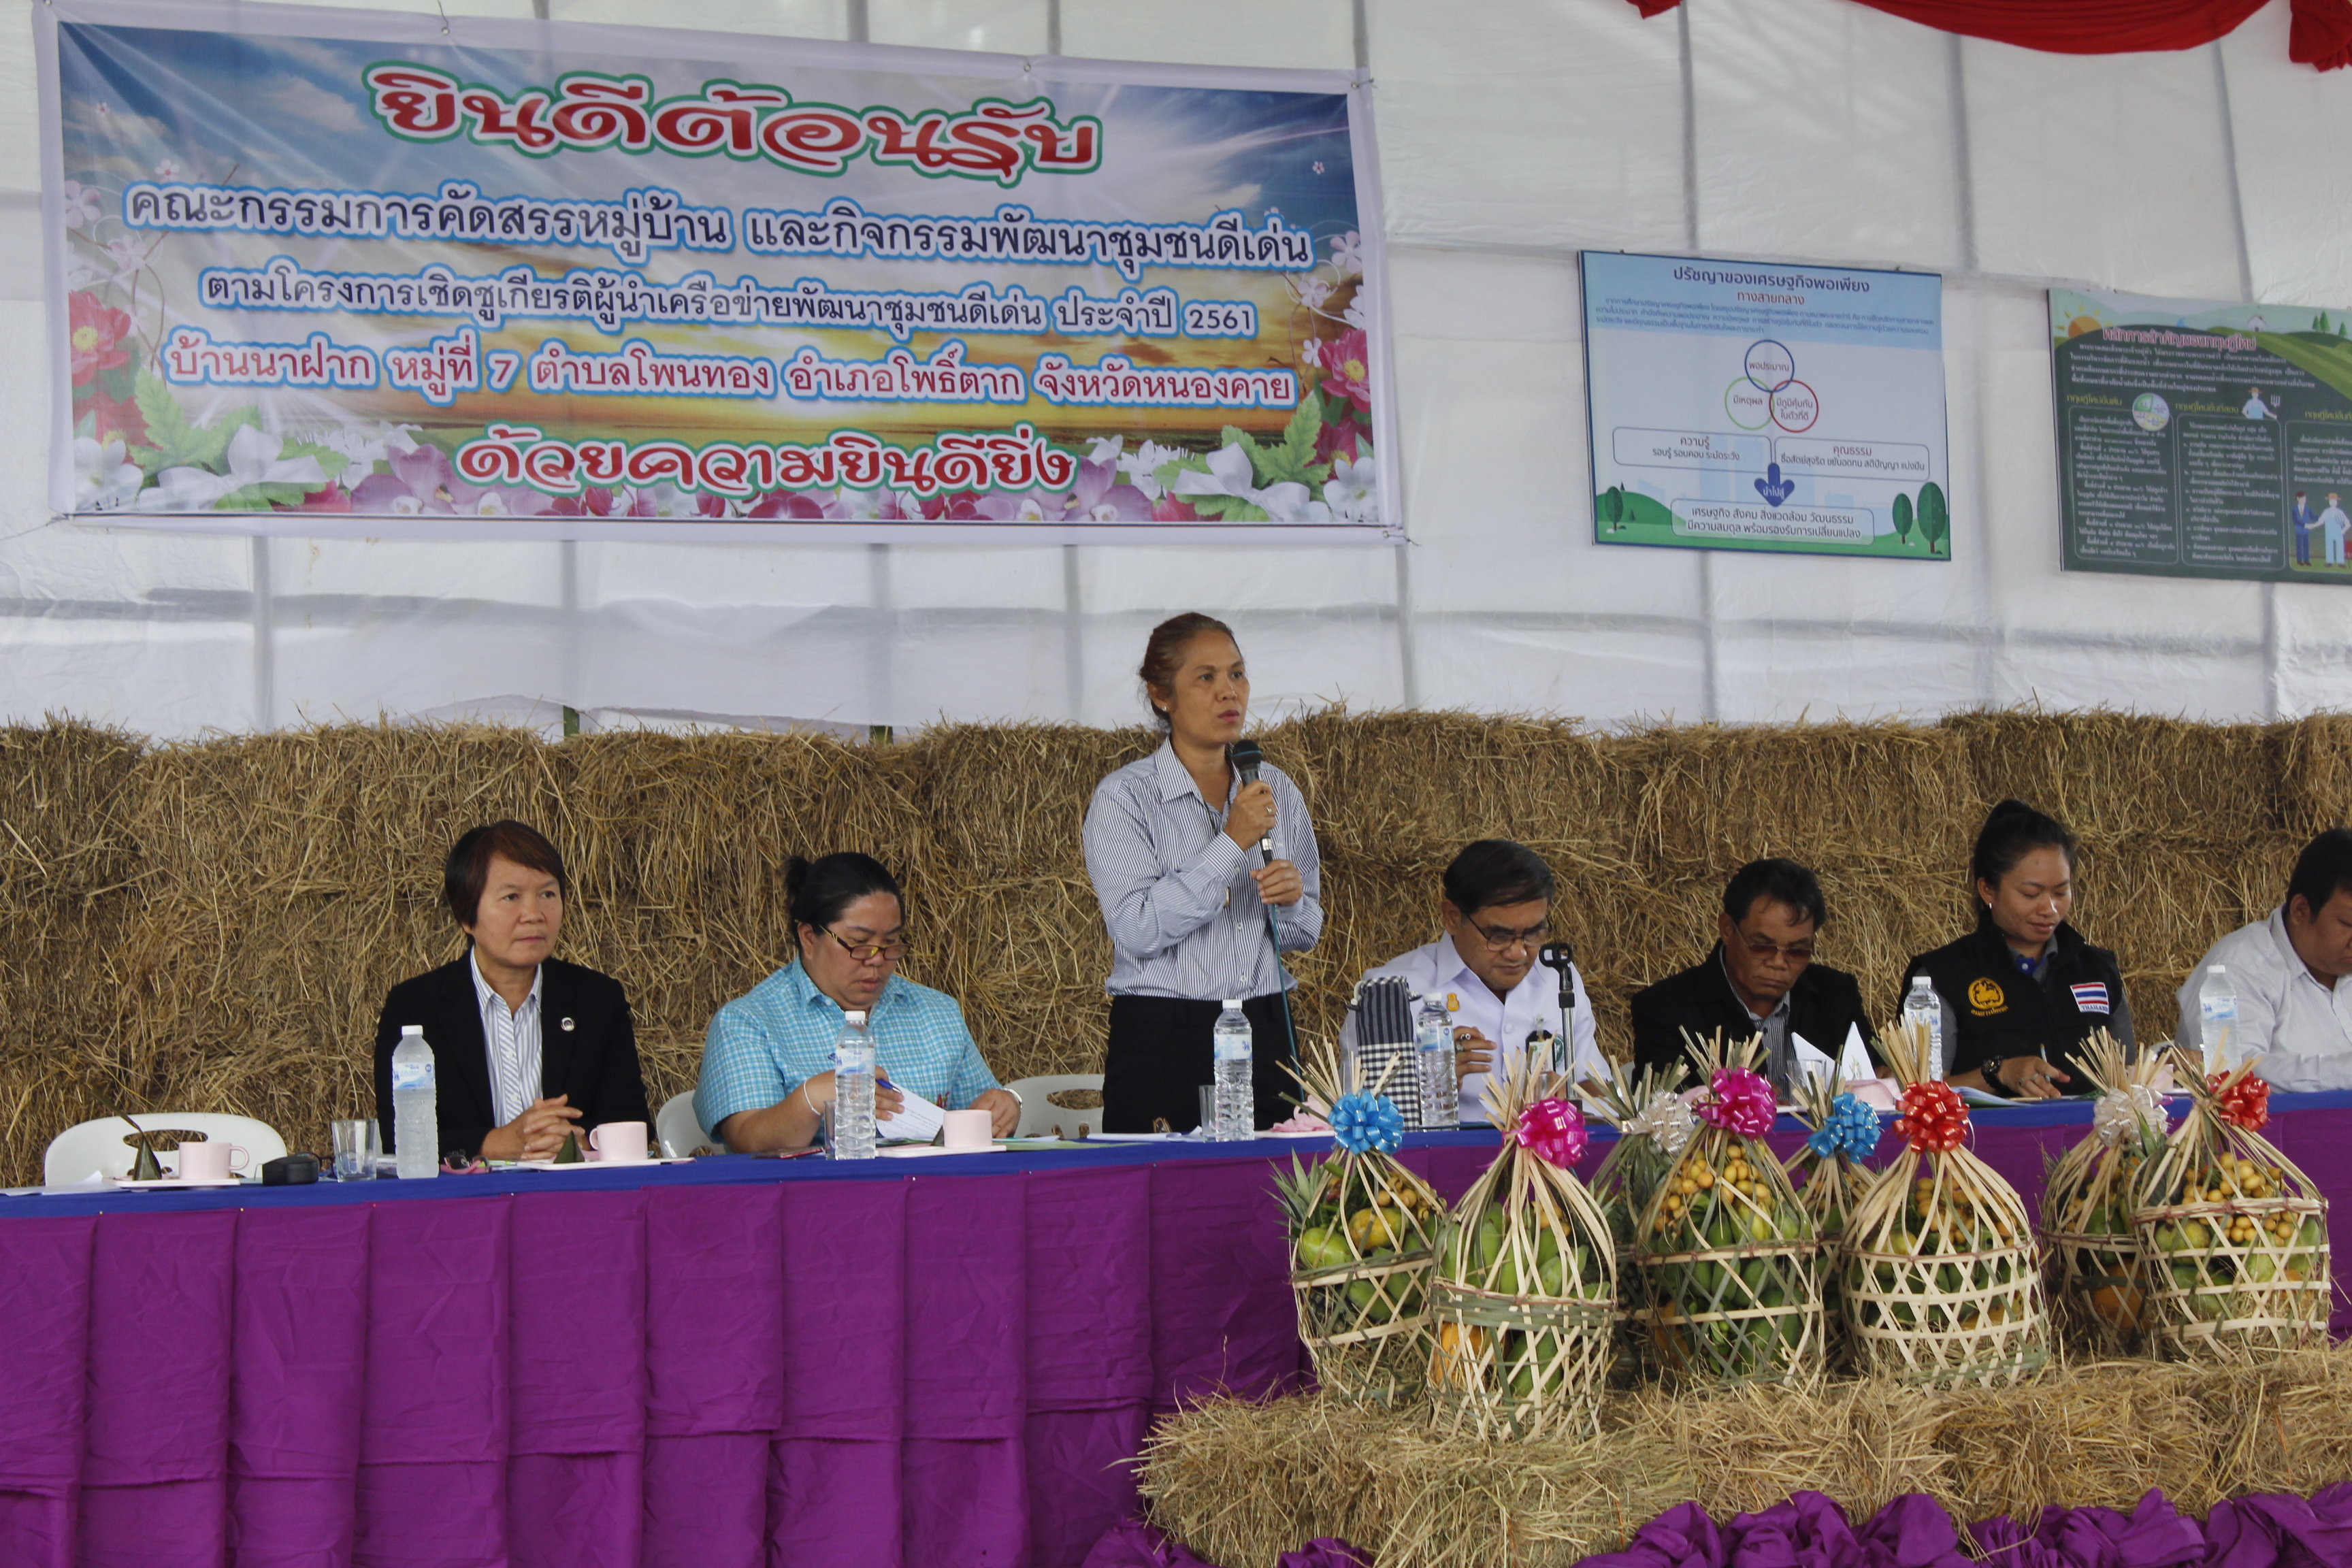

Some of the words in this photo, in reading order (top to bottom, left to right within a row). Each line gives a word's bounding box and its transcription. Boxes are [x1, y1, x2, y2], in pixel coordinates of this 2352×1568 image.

[372, 71, 1094, 179] ยินดีต้อนรับ
[131, 189, 728, 257] คณะกรรมการคัดสรรหมู่บ้าน
[751, 206, 1309, 274] และกิจกรรมพัฒนาชุมชนดีเด่น
[1673, 265, 1870, 292] ปรัชญาของเศรษฐกิจพอเพียง
[208, 265, 1042, 334] ตามโครงการเชิดชูเกียรติผู้นำเครือข่ายพัฒนาชุมชนดีเด่น
[1058, 295, 1172, 329] ประจำปี
[1189, 310, 1251, 330] 2561
[1737, 290, 1806, 305] ทางสายกลาง
[171, 335, 371, 380] บ้านนาฝาก
[392, 335, 473, 396] หมู่ที่
[494, 359, 512, 383] 7
[536, 347, 770, 389] ตำบลโพนทอง
[789, 348, 1020, 396] อำเภอโพธิ์ตาก
[1039, 361, 1290, 400] จังหวัดหนองคาย
[1749, 361, 1790, 372] พอประมาณ
[1733, 394, 1763, 406] มีเหตุผล
[1680, 436, 1710, 450] ความรู้
[1833, 445, 1872, 457] คุณธรรม
[460, 428, 1073, 492] ด้วยความยินดียิ่ง
[1652, 447, 1671, 459] รอบรู้
[1673, 449, 1704, 458] รอบคอบ
[1763, 485, 1785, 500] นำไปสู่
[1692, 507, 1730, 520] เศรษฐกิจ
[1733, 508, 1757, 519] สังคม
[1760, 506, 1807, 522] สิ่งแวดล้อม
[1810, 512, 1853, 525] วัฒนธรรม
[1688, 521, 1741, 536] มีความสมดุล
[1744, 523, 1861, 539] พร้อมรองรับการเปลี่ยนแปลง
[2082, 1004, 2108, 1012] THAILAND
